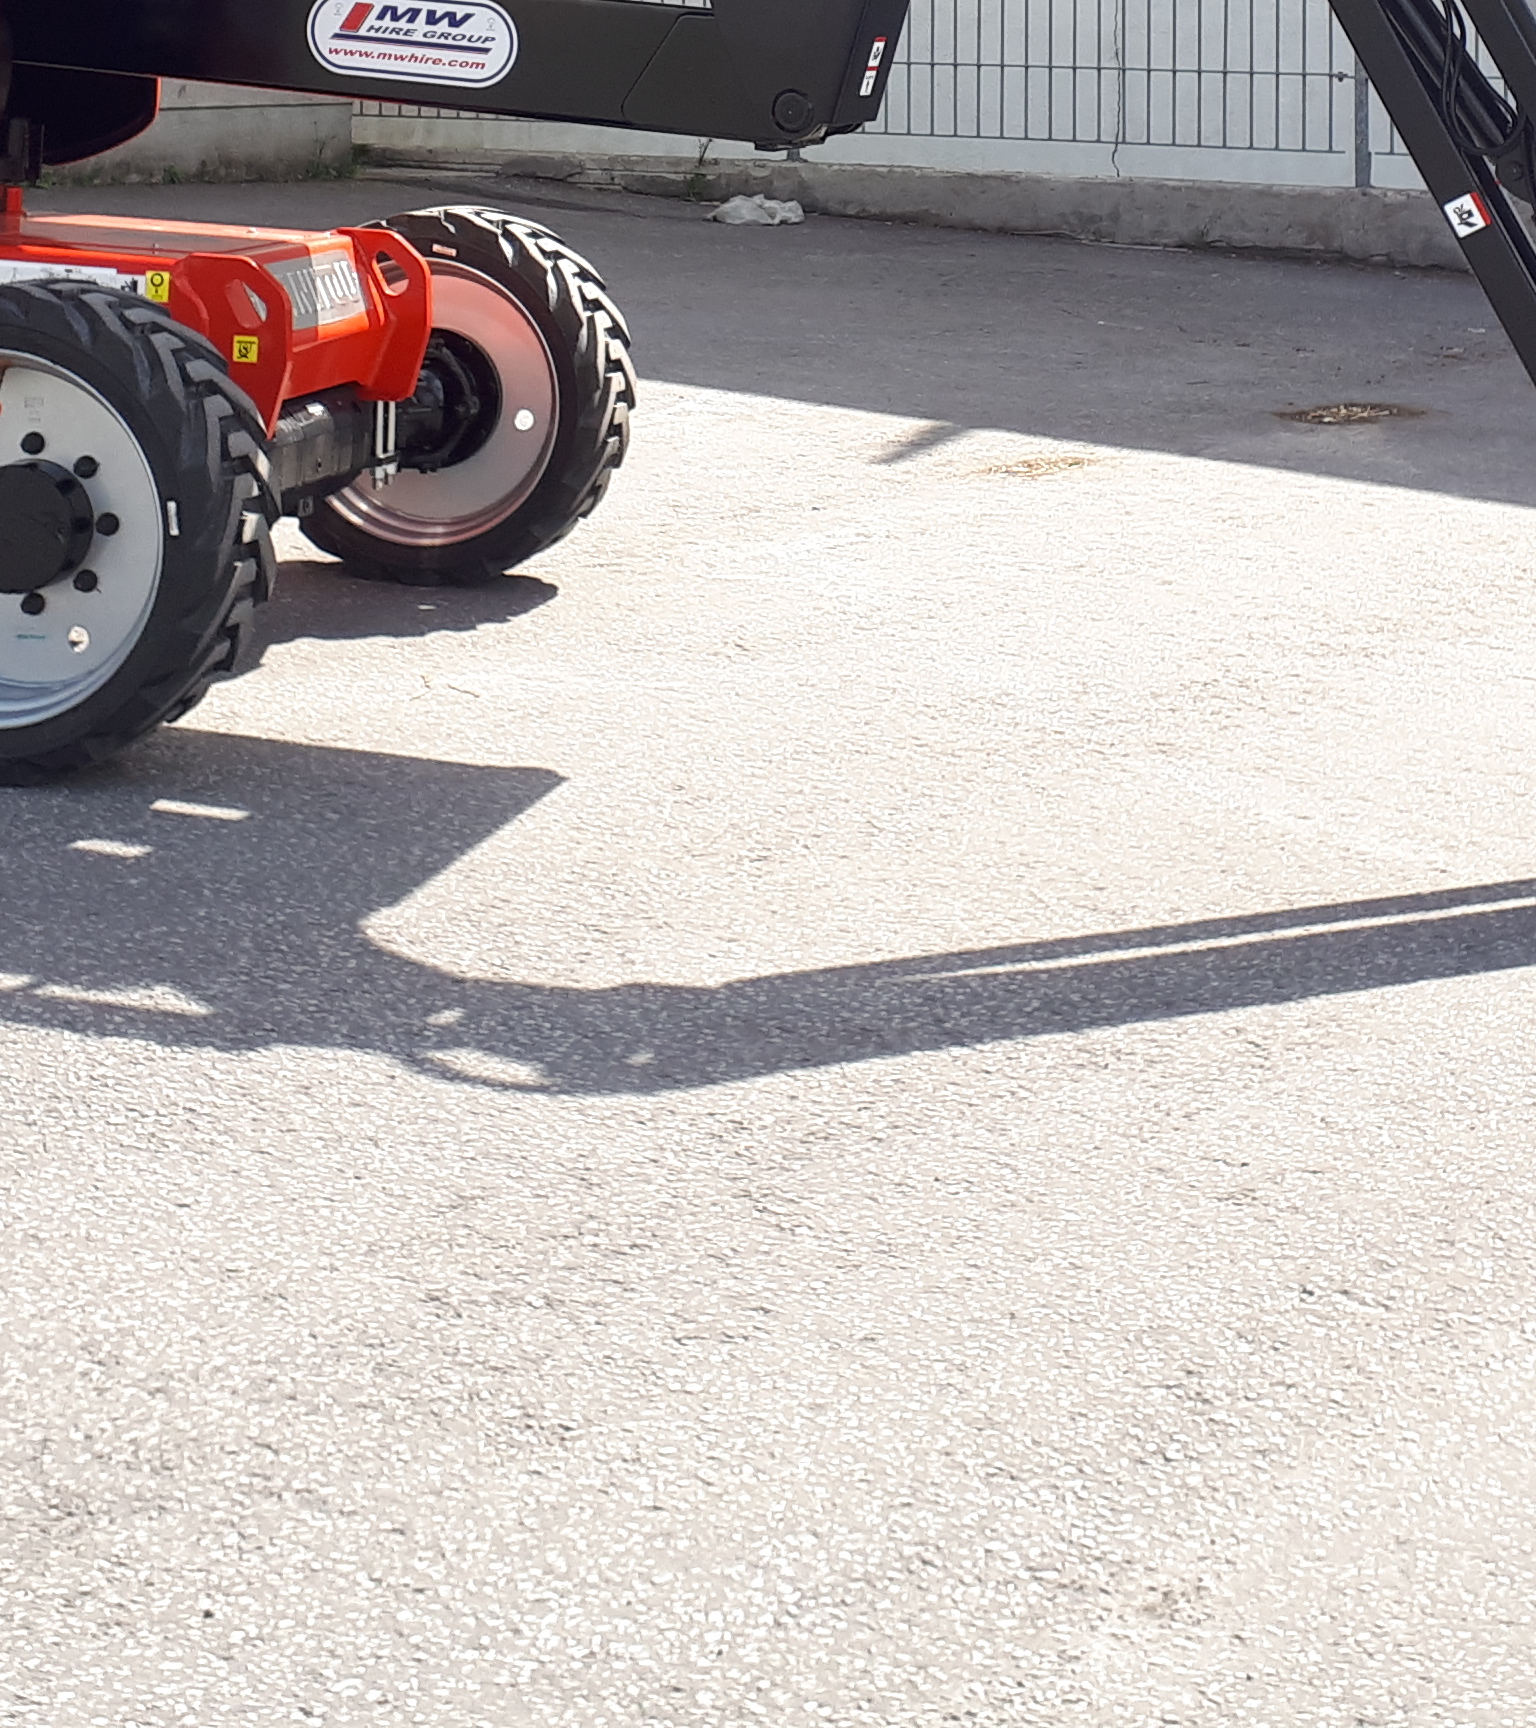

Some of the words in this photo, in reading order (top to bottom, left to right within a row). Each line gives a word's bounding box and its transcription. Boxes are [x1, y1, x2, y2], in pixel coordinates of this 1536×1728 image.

[375, 5, 476, 29] MW
[366, 24, 416, 37] HIRE
[422, 30, 496, 45] GROUP
[328, 46, 486, 70] www.mwhire.com
